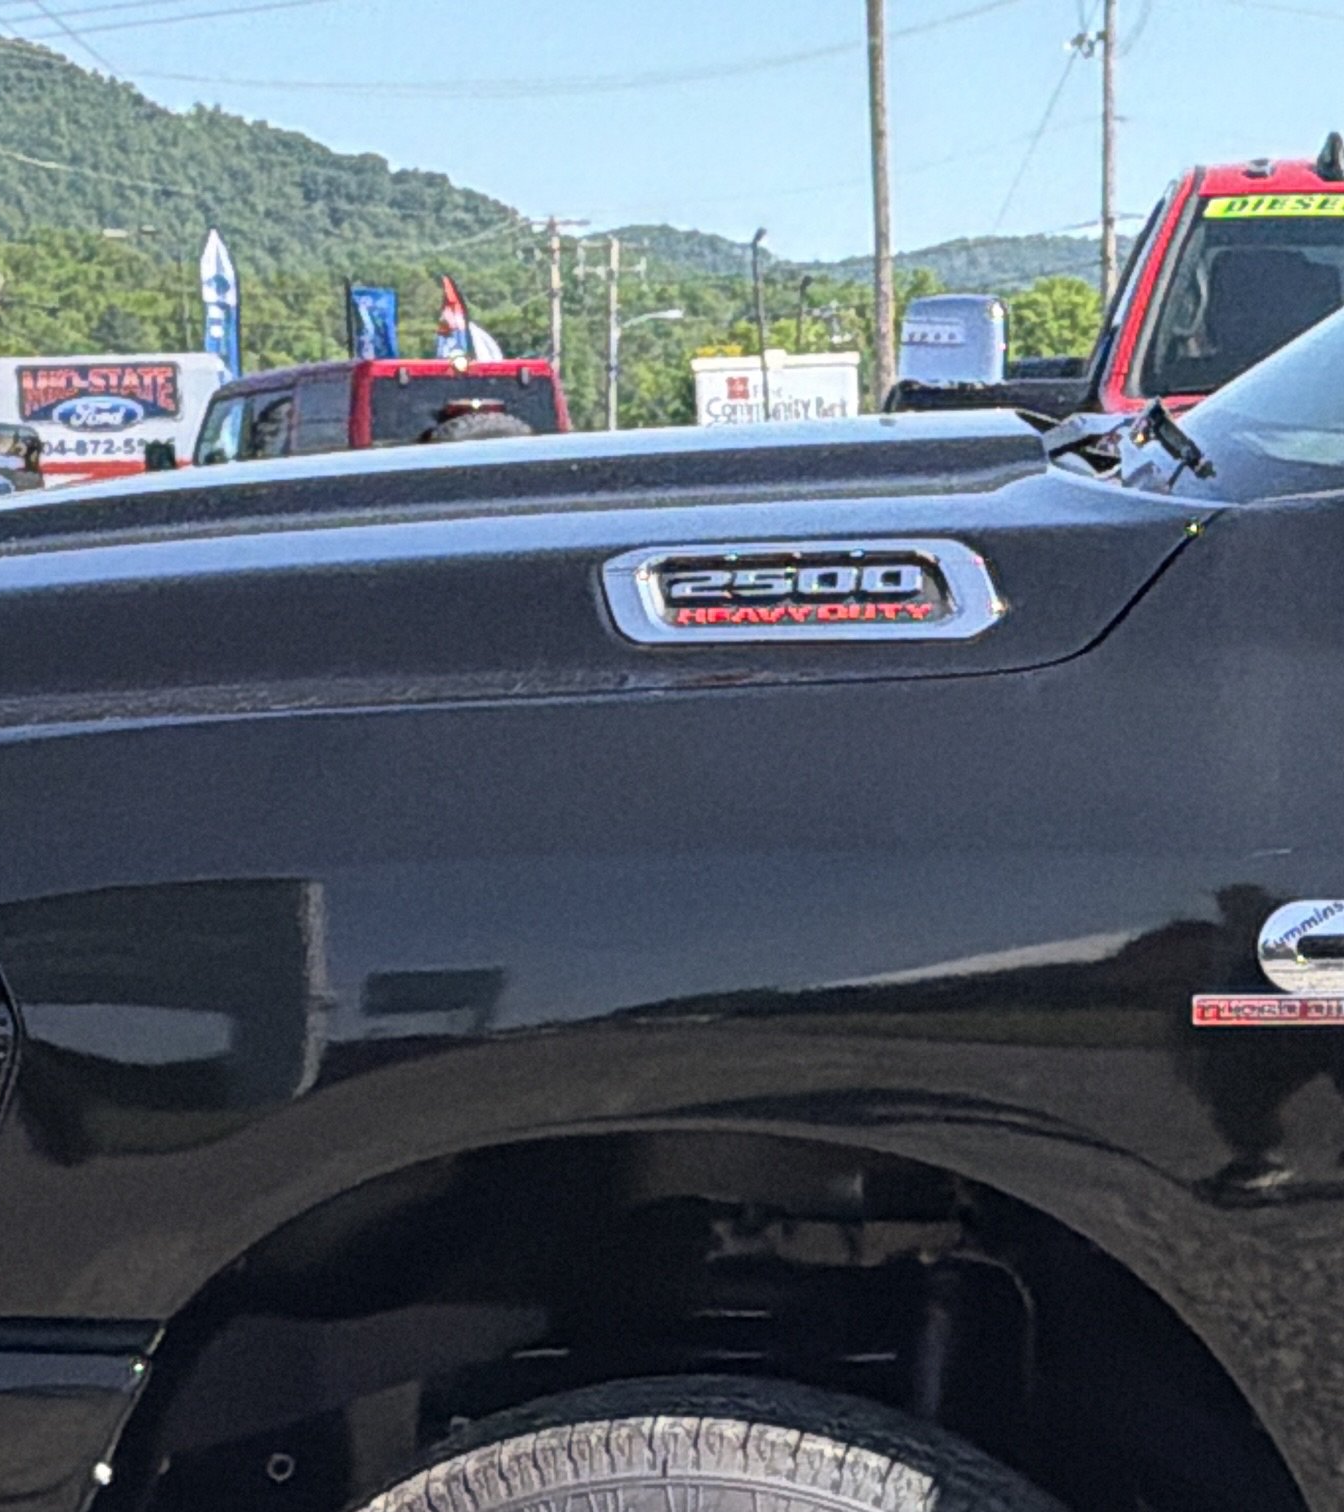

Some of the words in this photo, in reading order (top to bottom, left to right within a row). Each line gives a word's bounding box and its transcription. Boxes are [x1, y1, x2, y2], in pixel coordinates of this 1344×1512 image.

[20, 366, 177, 416] MID-STATE
[69, 401, 126, 427] Ford
[668, 564, 924, 600] 2500
[676, 605, 811, 625] HEAVY
[816, 602, 935, 621] DUTY
